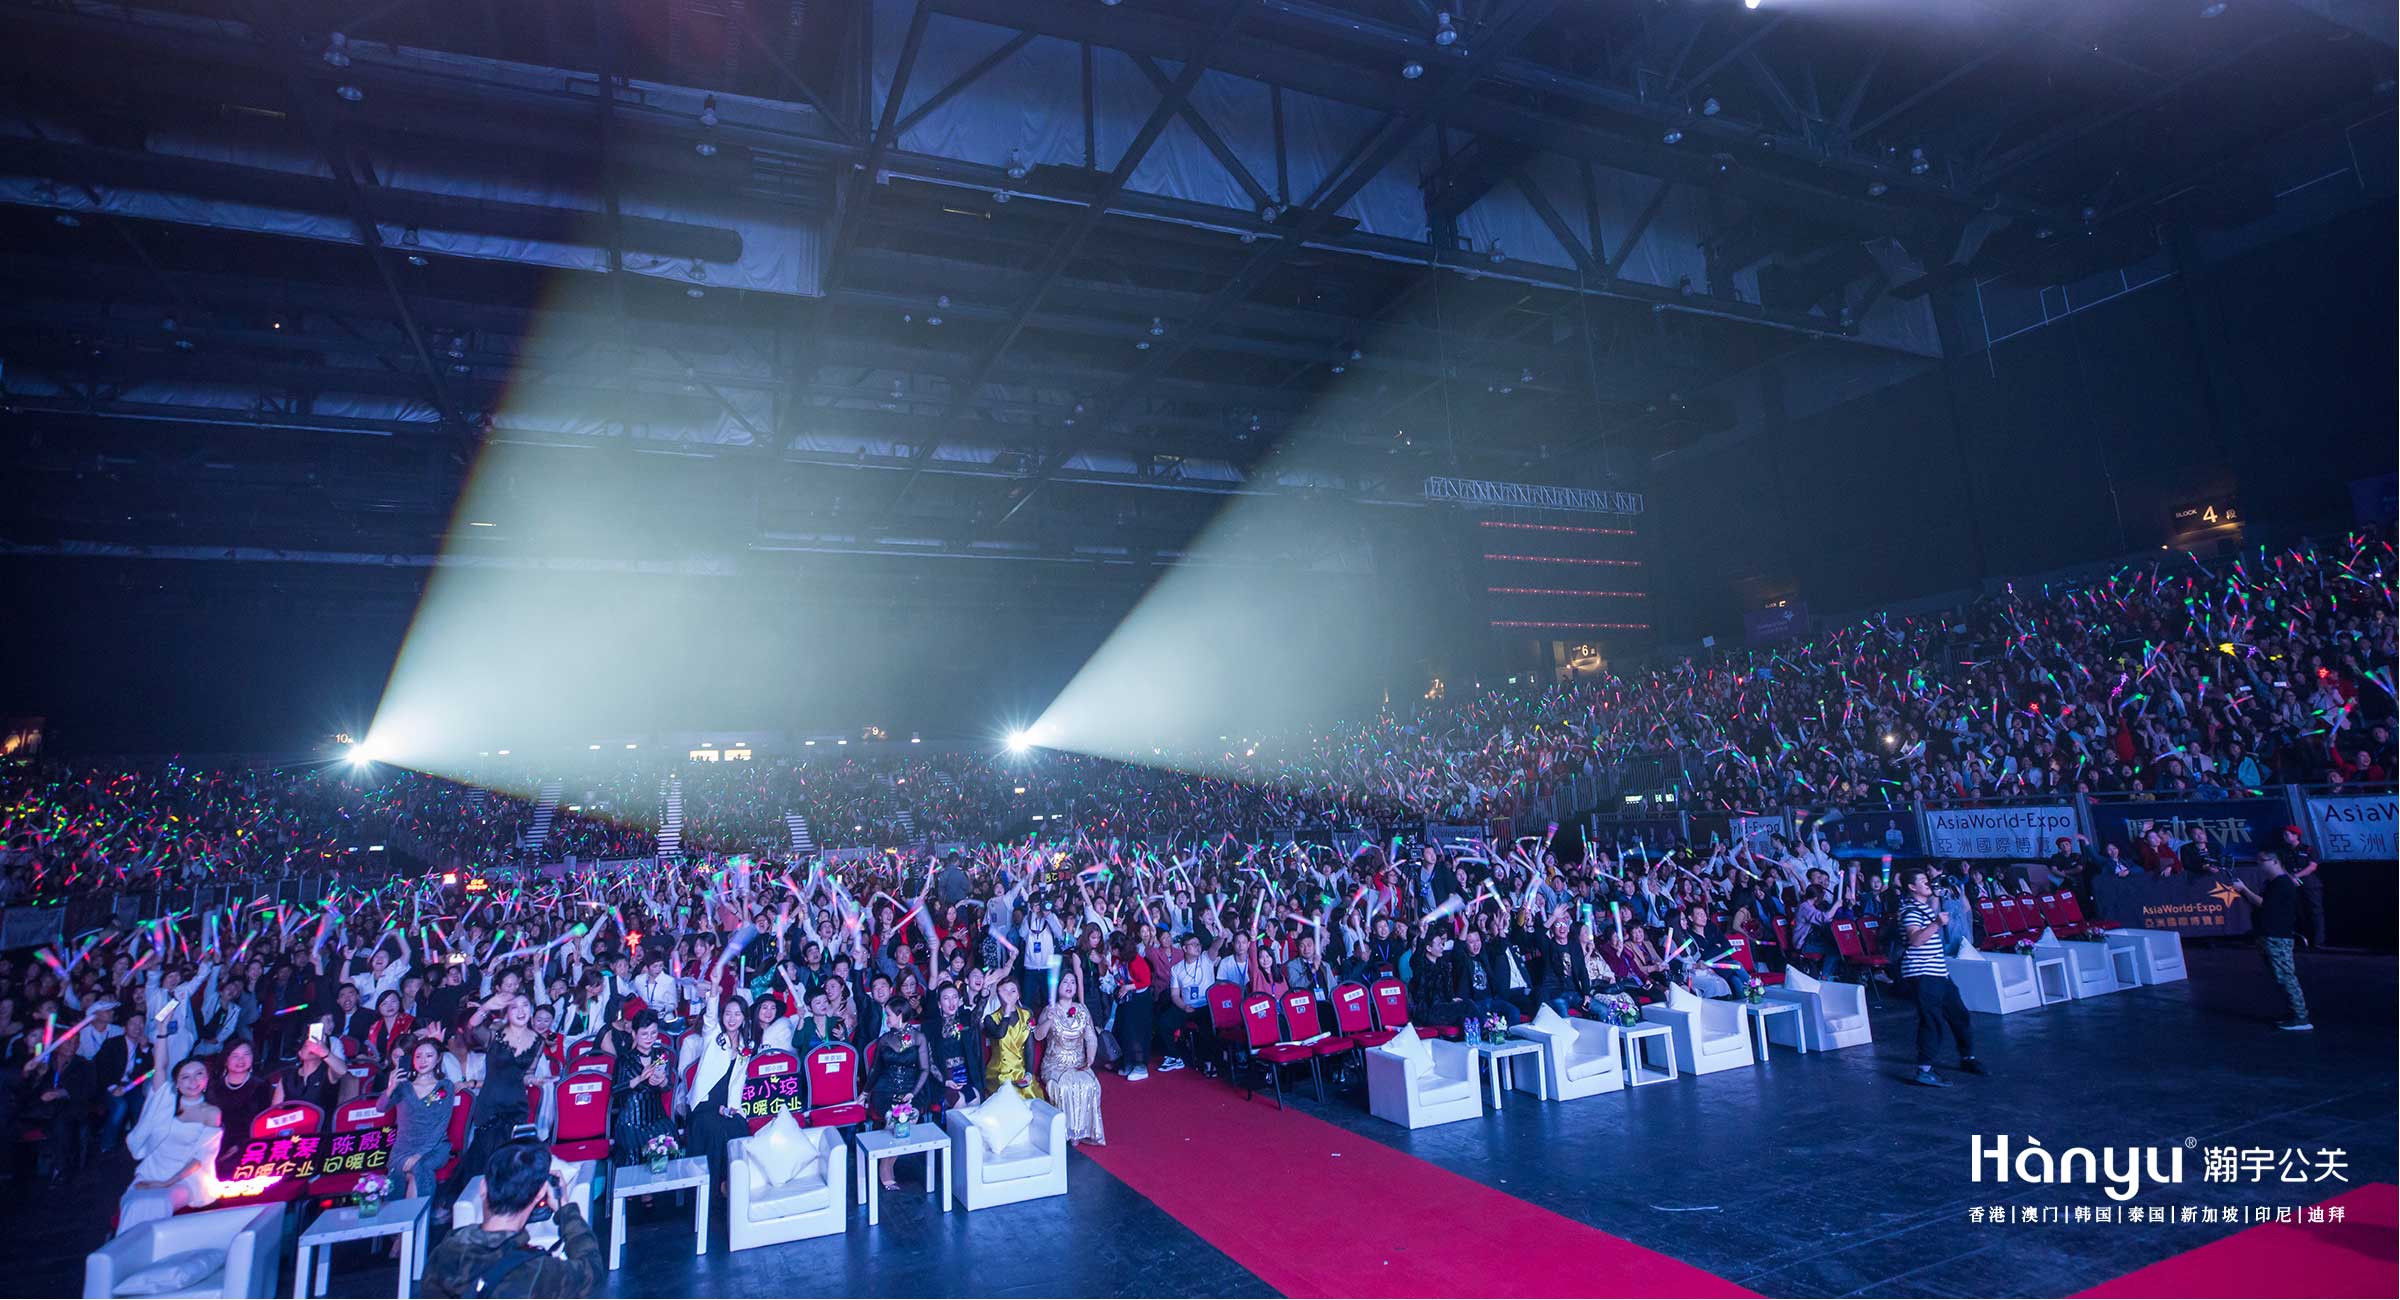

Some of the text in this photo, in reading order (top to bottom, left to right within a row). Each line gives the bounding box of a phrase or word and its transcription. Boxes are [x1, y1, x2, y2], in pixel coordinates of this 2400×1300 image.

[2202, 504, 2218, 523] 4
[1581, 645, 1589, 656] 6
[871, 726, 879, 736] 9
[335, 732, 349, 744] 10
[1936, 812, 2071, 832] AsiaWorld-Expo
[2328, 832, 2399, 854] 亞洲
[2142, 902, 2223, 915] AsiaWorld-Expo
